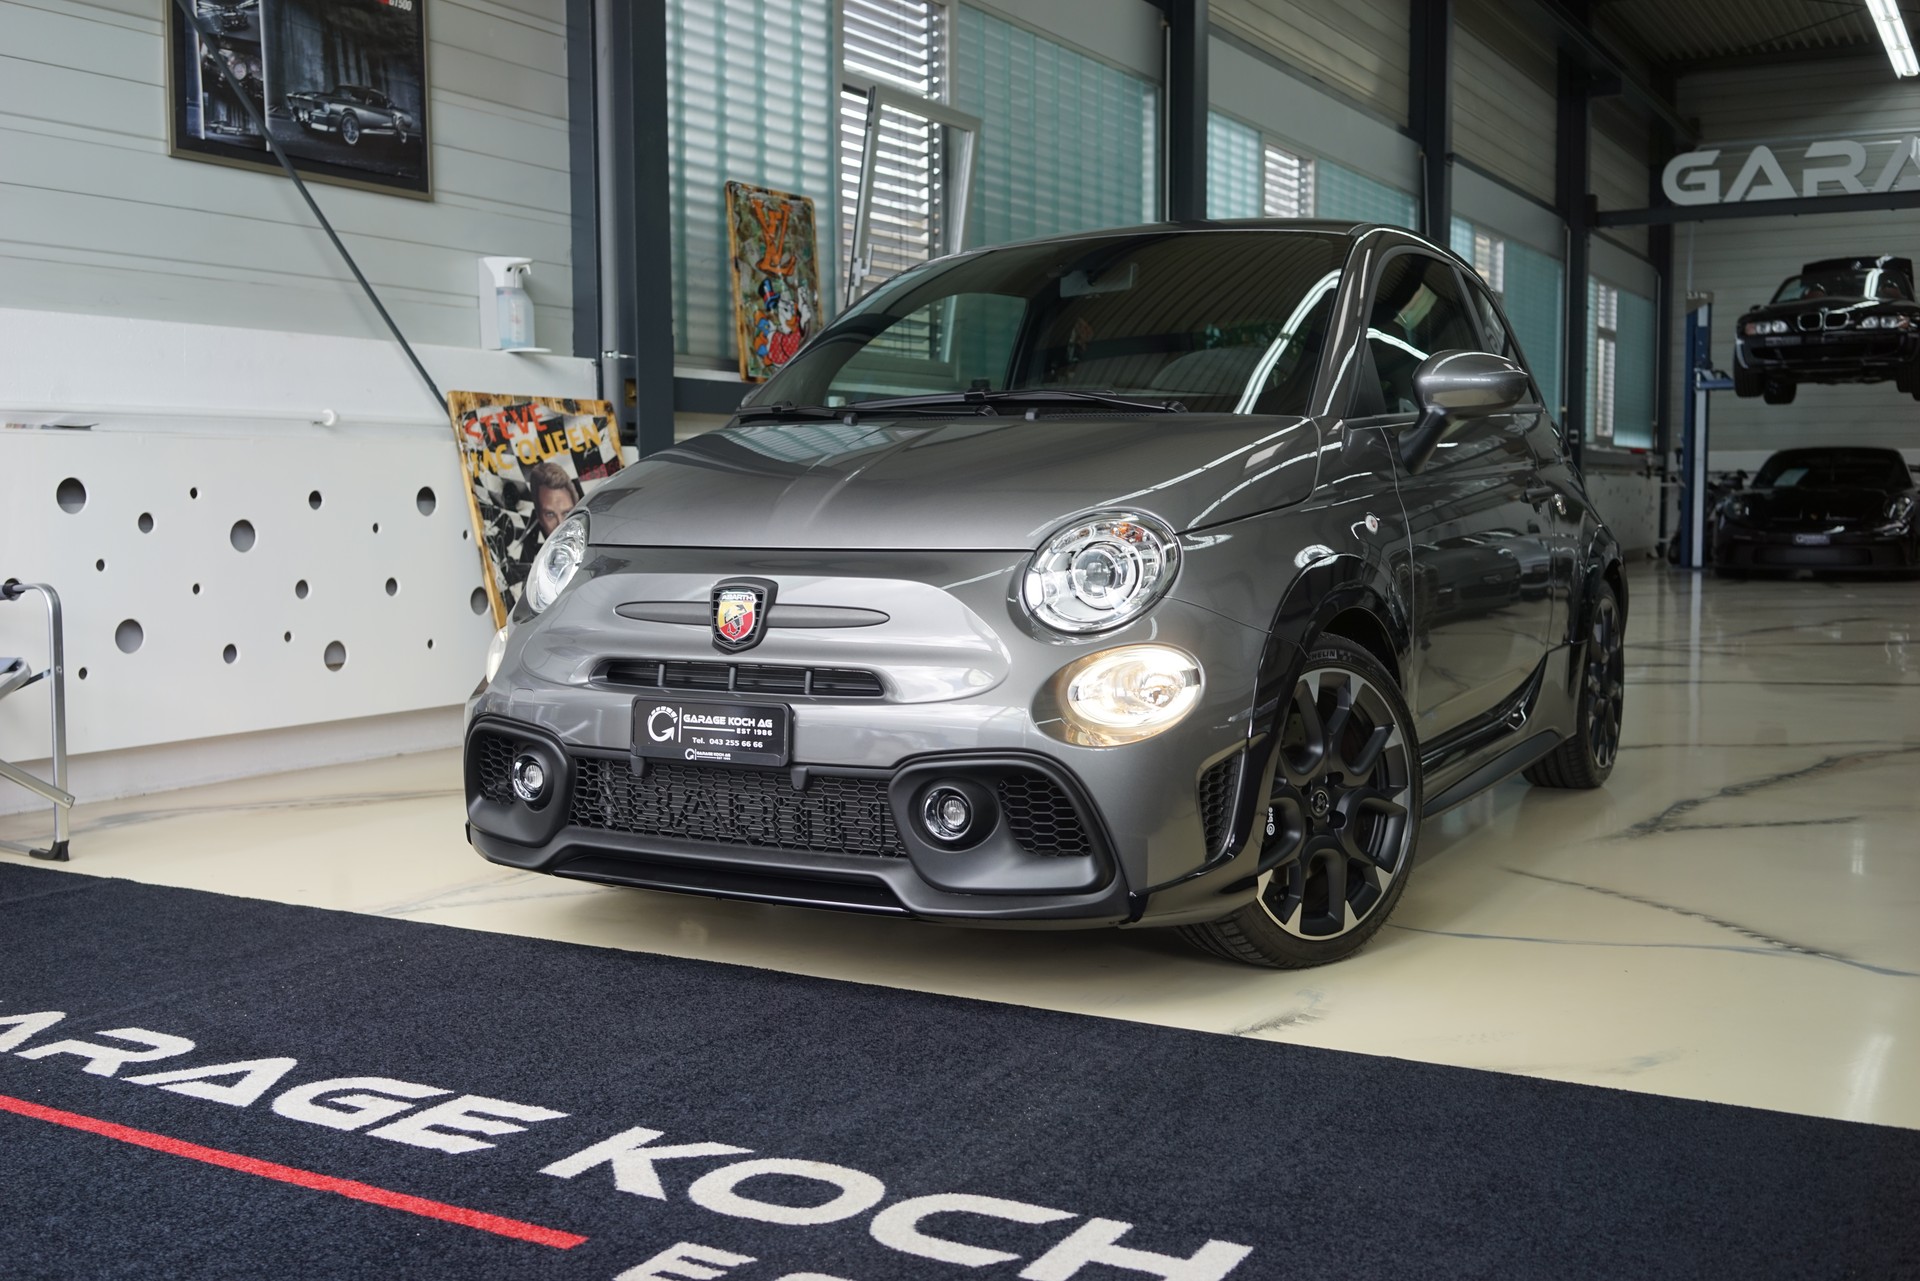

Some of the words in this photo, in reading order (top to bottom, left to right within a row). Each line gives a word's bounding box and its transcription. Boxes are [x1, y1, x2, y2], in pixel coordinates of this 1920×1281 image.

[464, 403, 548, 443] STEVE
[518, 423, 603, 465] QUEEN
[1310, 650, 1335, 660] HELIN
[683, 714, 726, 725] GARAGE
[728, 716, 755, 727] KOCH
[757, 718, 773, 728] AG
[692, 736, 705, 744] Tel.
[725, 739, 739, 747] 255
[741, 740, 751, 748] 66
[538, 1126, 1254, 1281] KOCH
